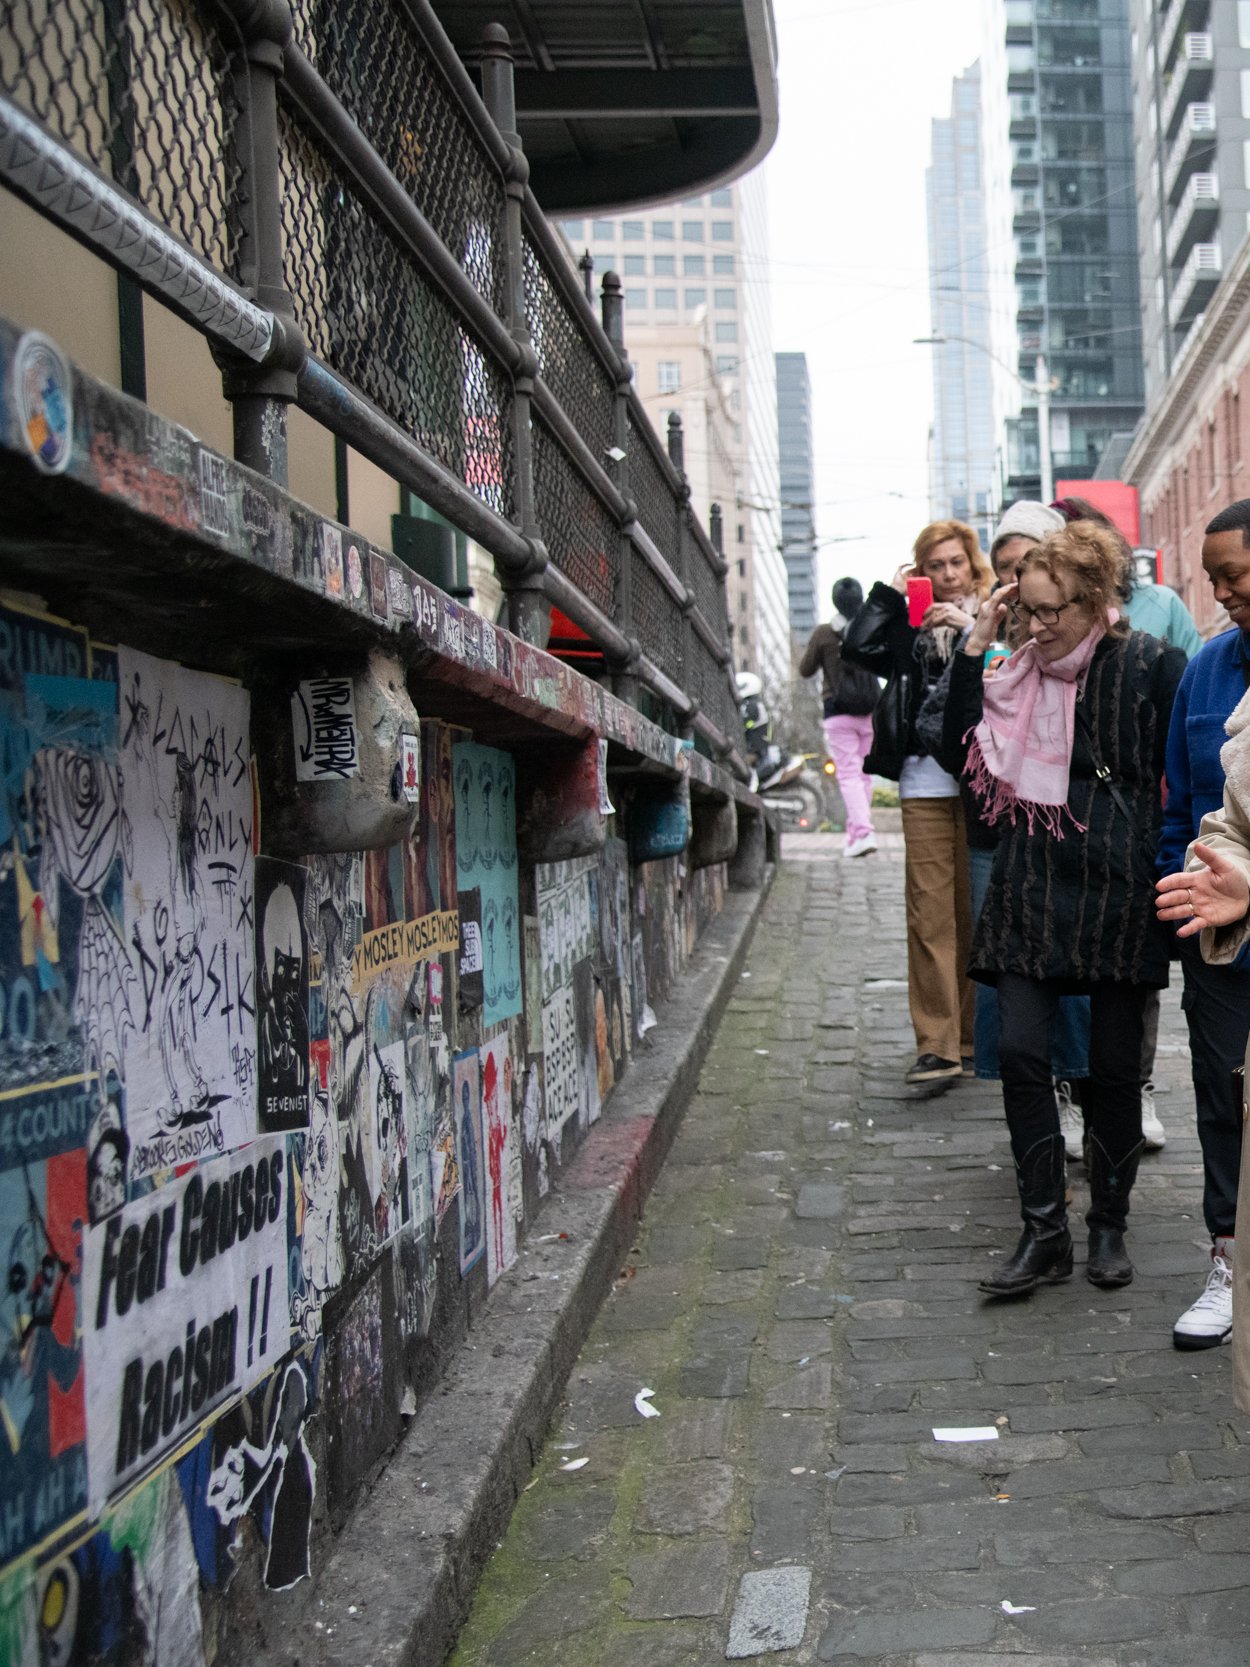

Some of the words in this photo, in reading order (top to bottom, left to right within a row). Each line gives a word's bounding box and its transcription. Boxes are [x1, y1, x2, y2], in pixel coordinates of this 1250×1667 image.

[363, 925, 405, 971] MOSLEY
[267, 1094, 308, 1113] SEVENIST
[96, 1201, 176, 1331] Fear
[180, 1149, 284, 1277] Causes
[116, 1304, 239, 1476] Racism
